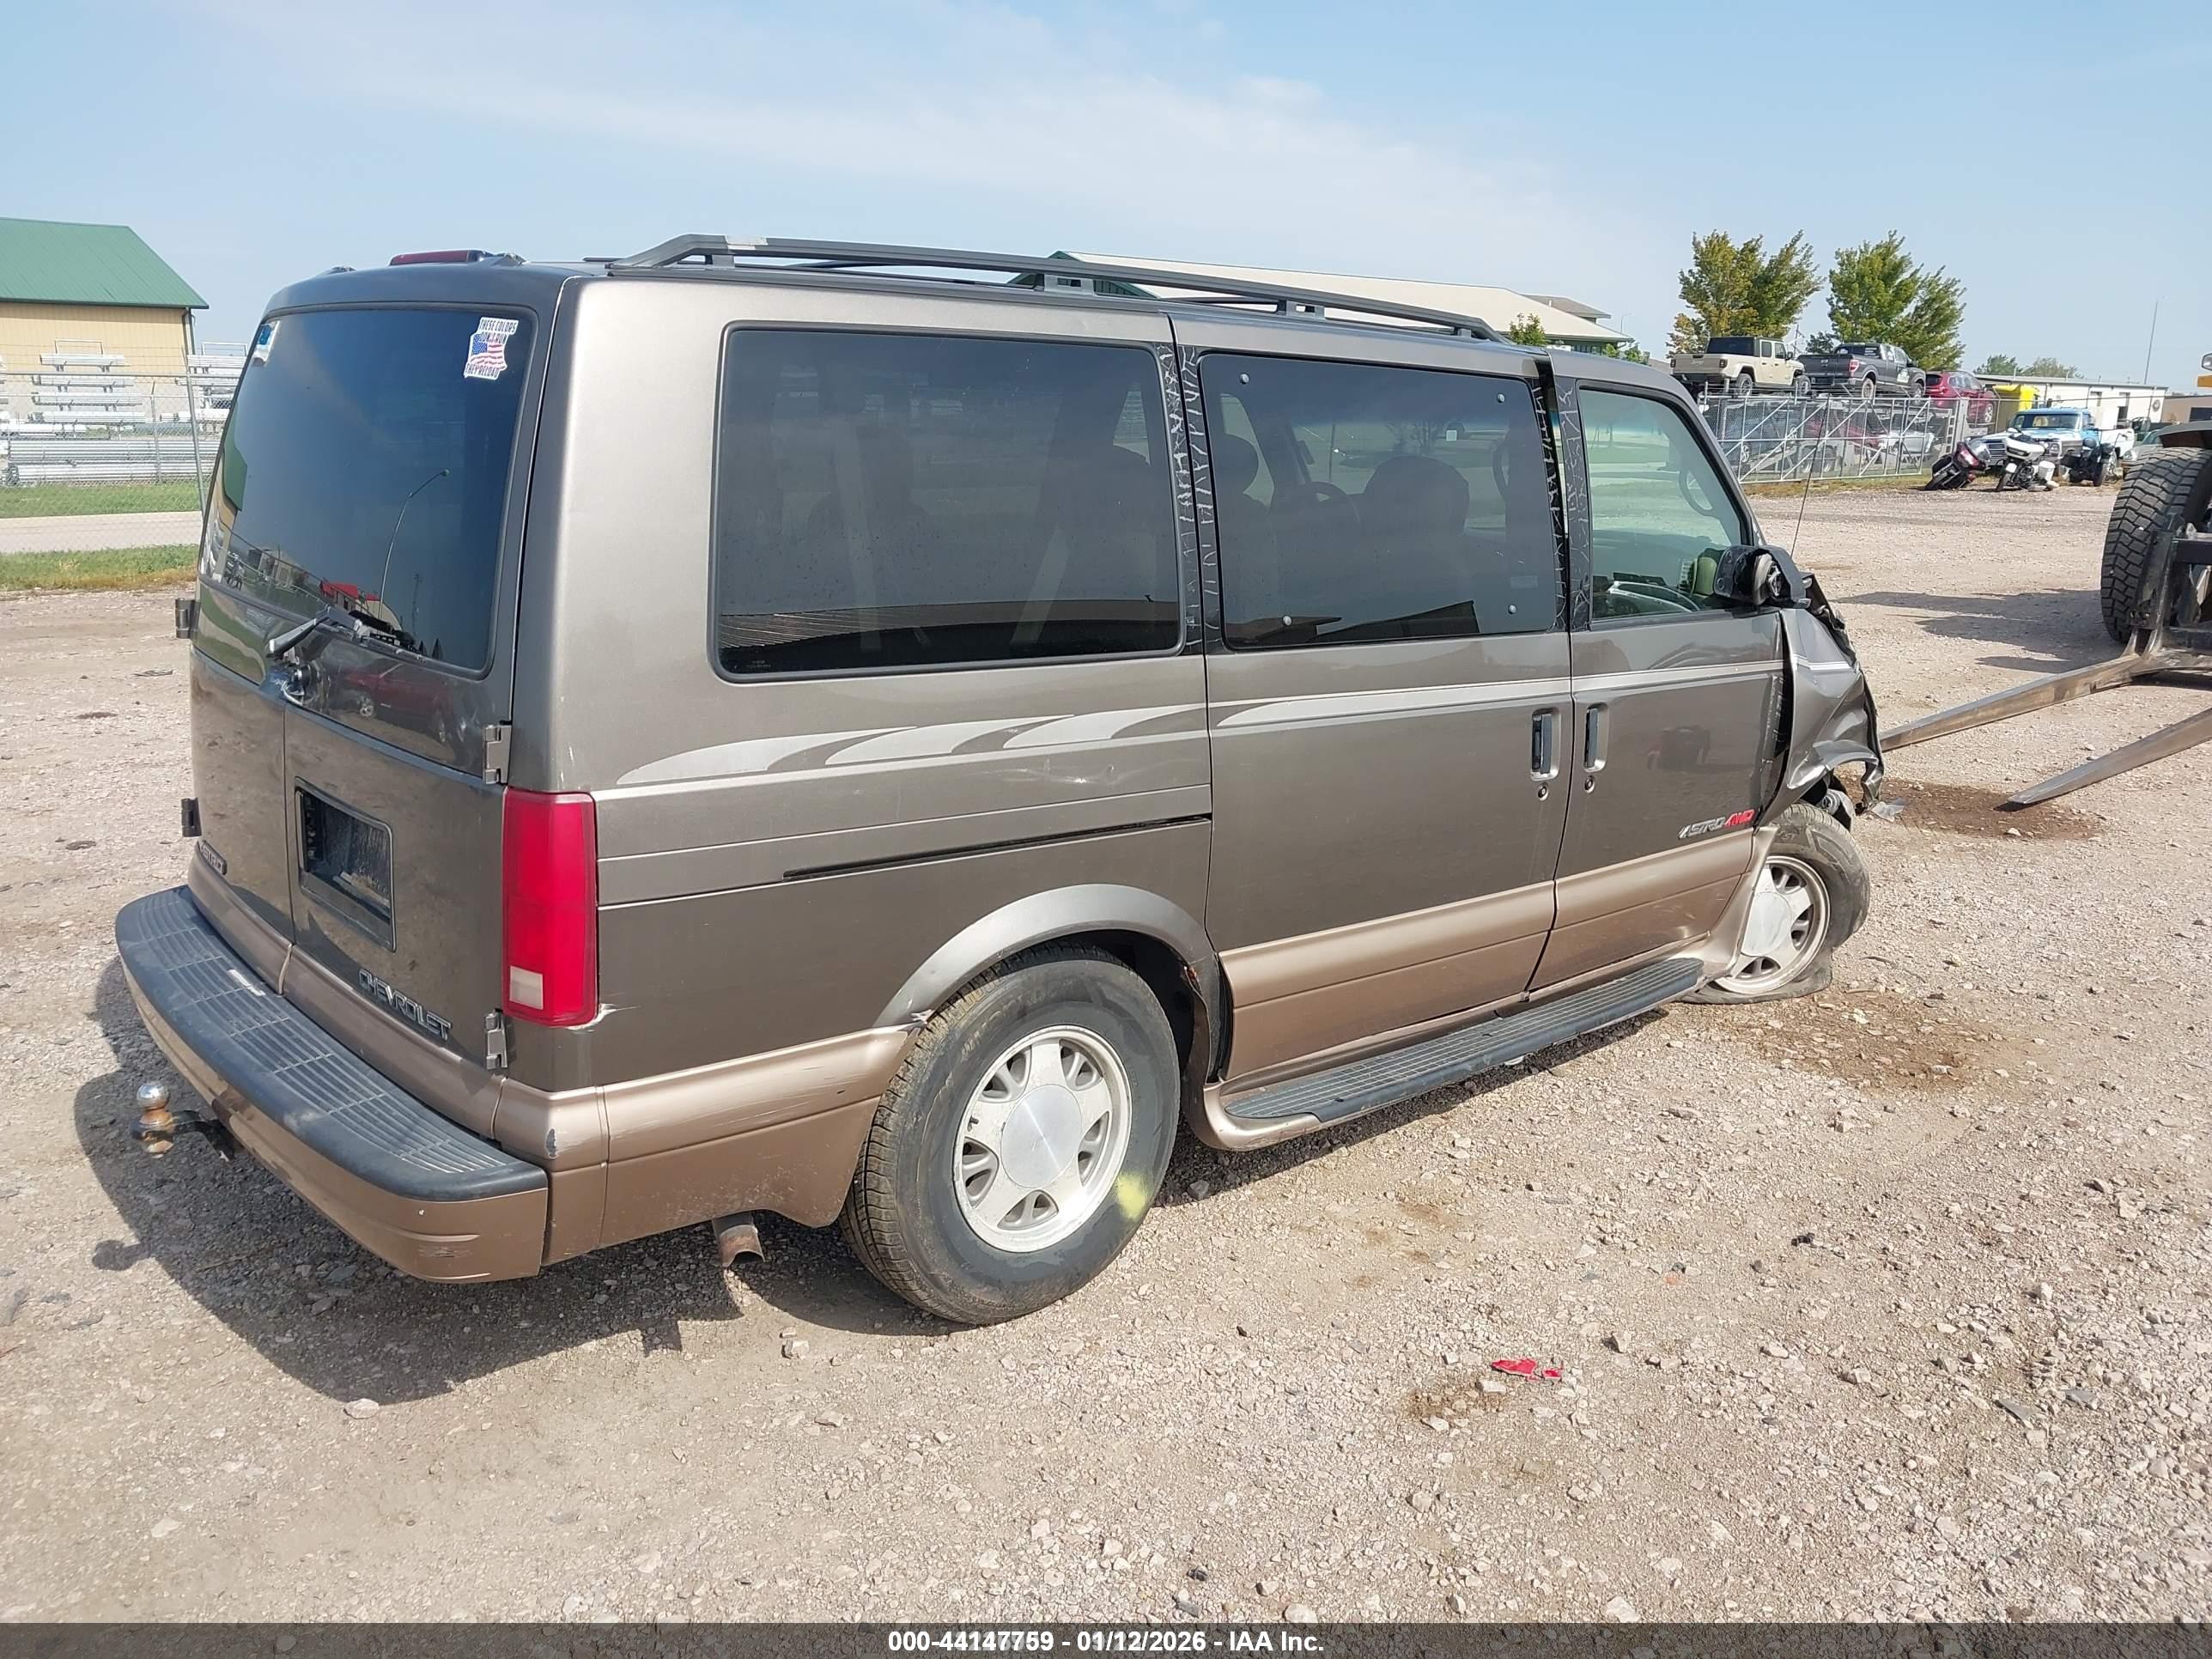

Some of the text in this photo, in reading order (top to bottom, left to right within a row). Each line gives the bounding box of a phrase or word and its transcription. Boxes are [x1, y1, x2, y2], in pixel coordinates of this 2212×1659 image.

[479, 319, 517, 332] THESE COLORS
[465, 362, 499, 378] THEY RELOAD
[1678, 809, 1755, 839] ASTRO AWD
[198, 840, 224, 874] ASTRO
[359, 968, 452, 1041] CHEVROLET
